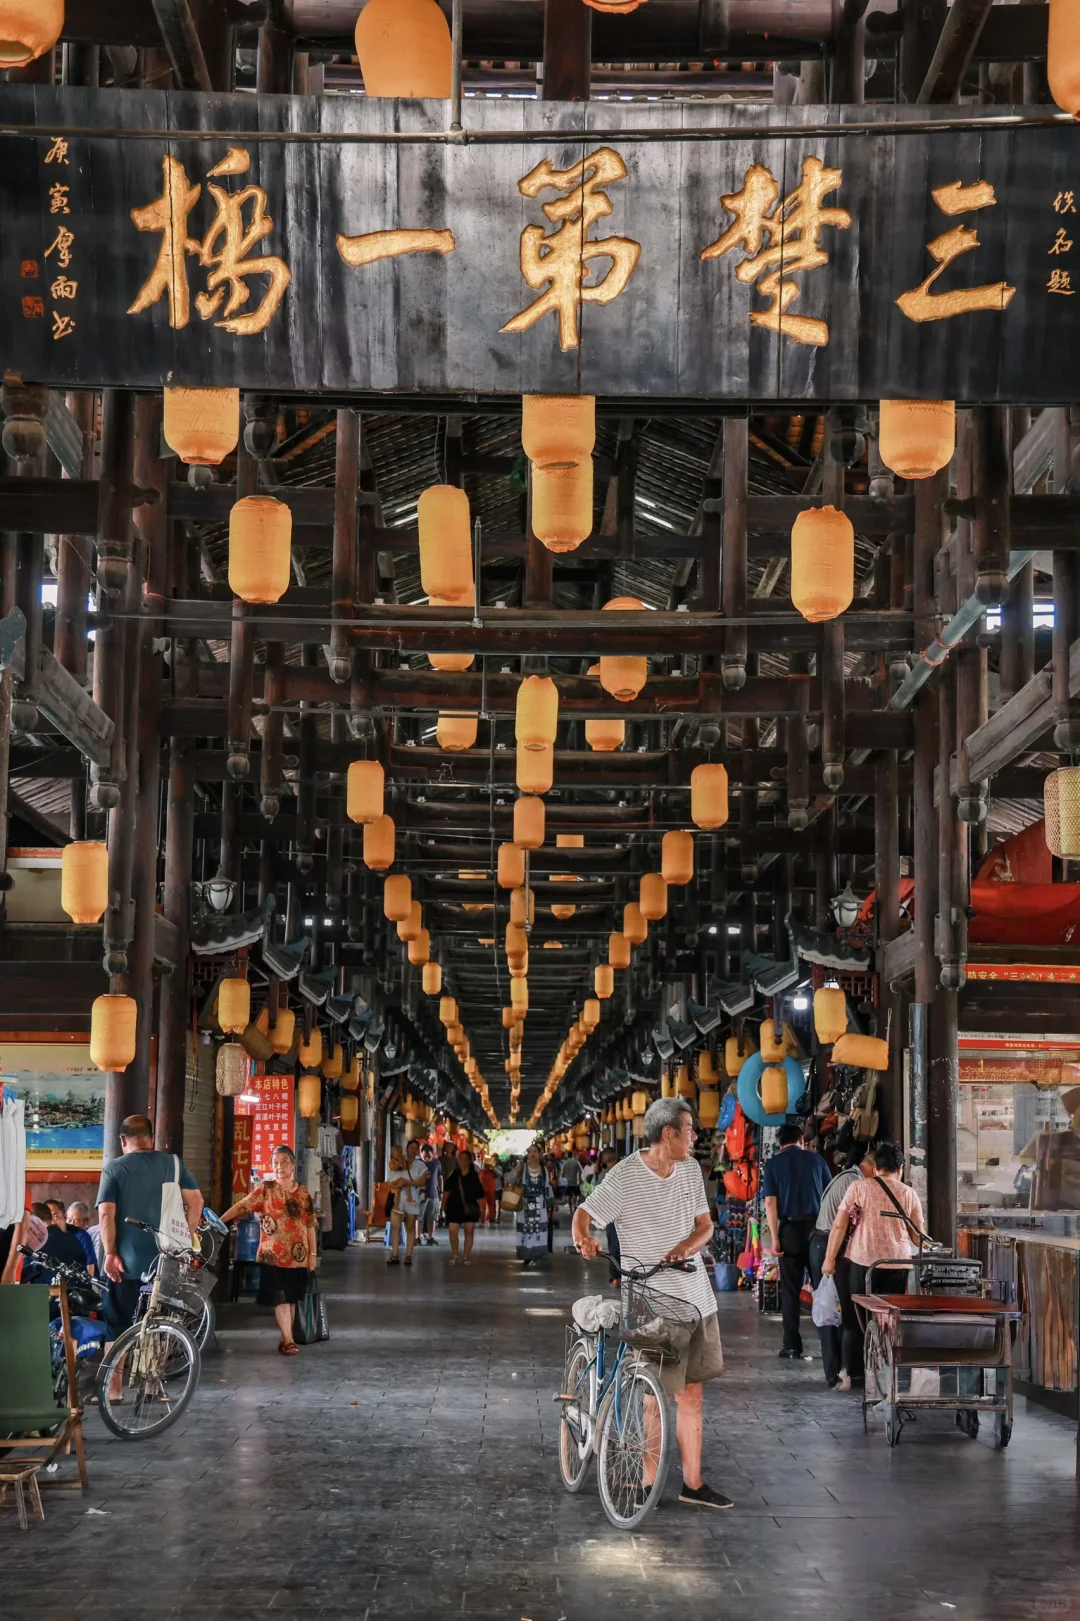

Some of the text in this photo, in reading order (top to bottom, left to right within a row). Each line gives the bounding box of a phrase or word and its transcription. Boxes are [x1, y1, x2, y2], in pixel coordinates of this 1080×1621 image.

[965, 970, 998, 979] 防安全
[255, 1078, 288, 1090] 本店特色
